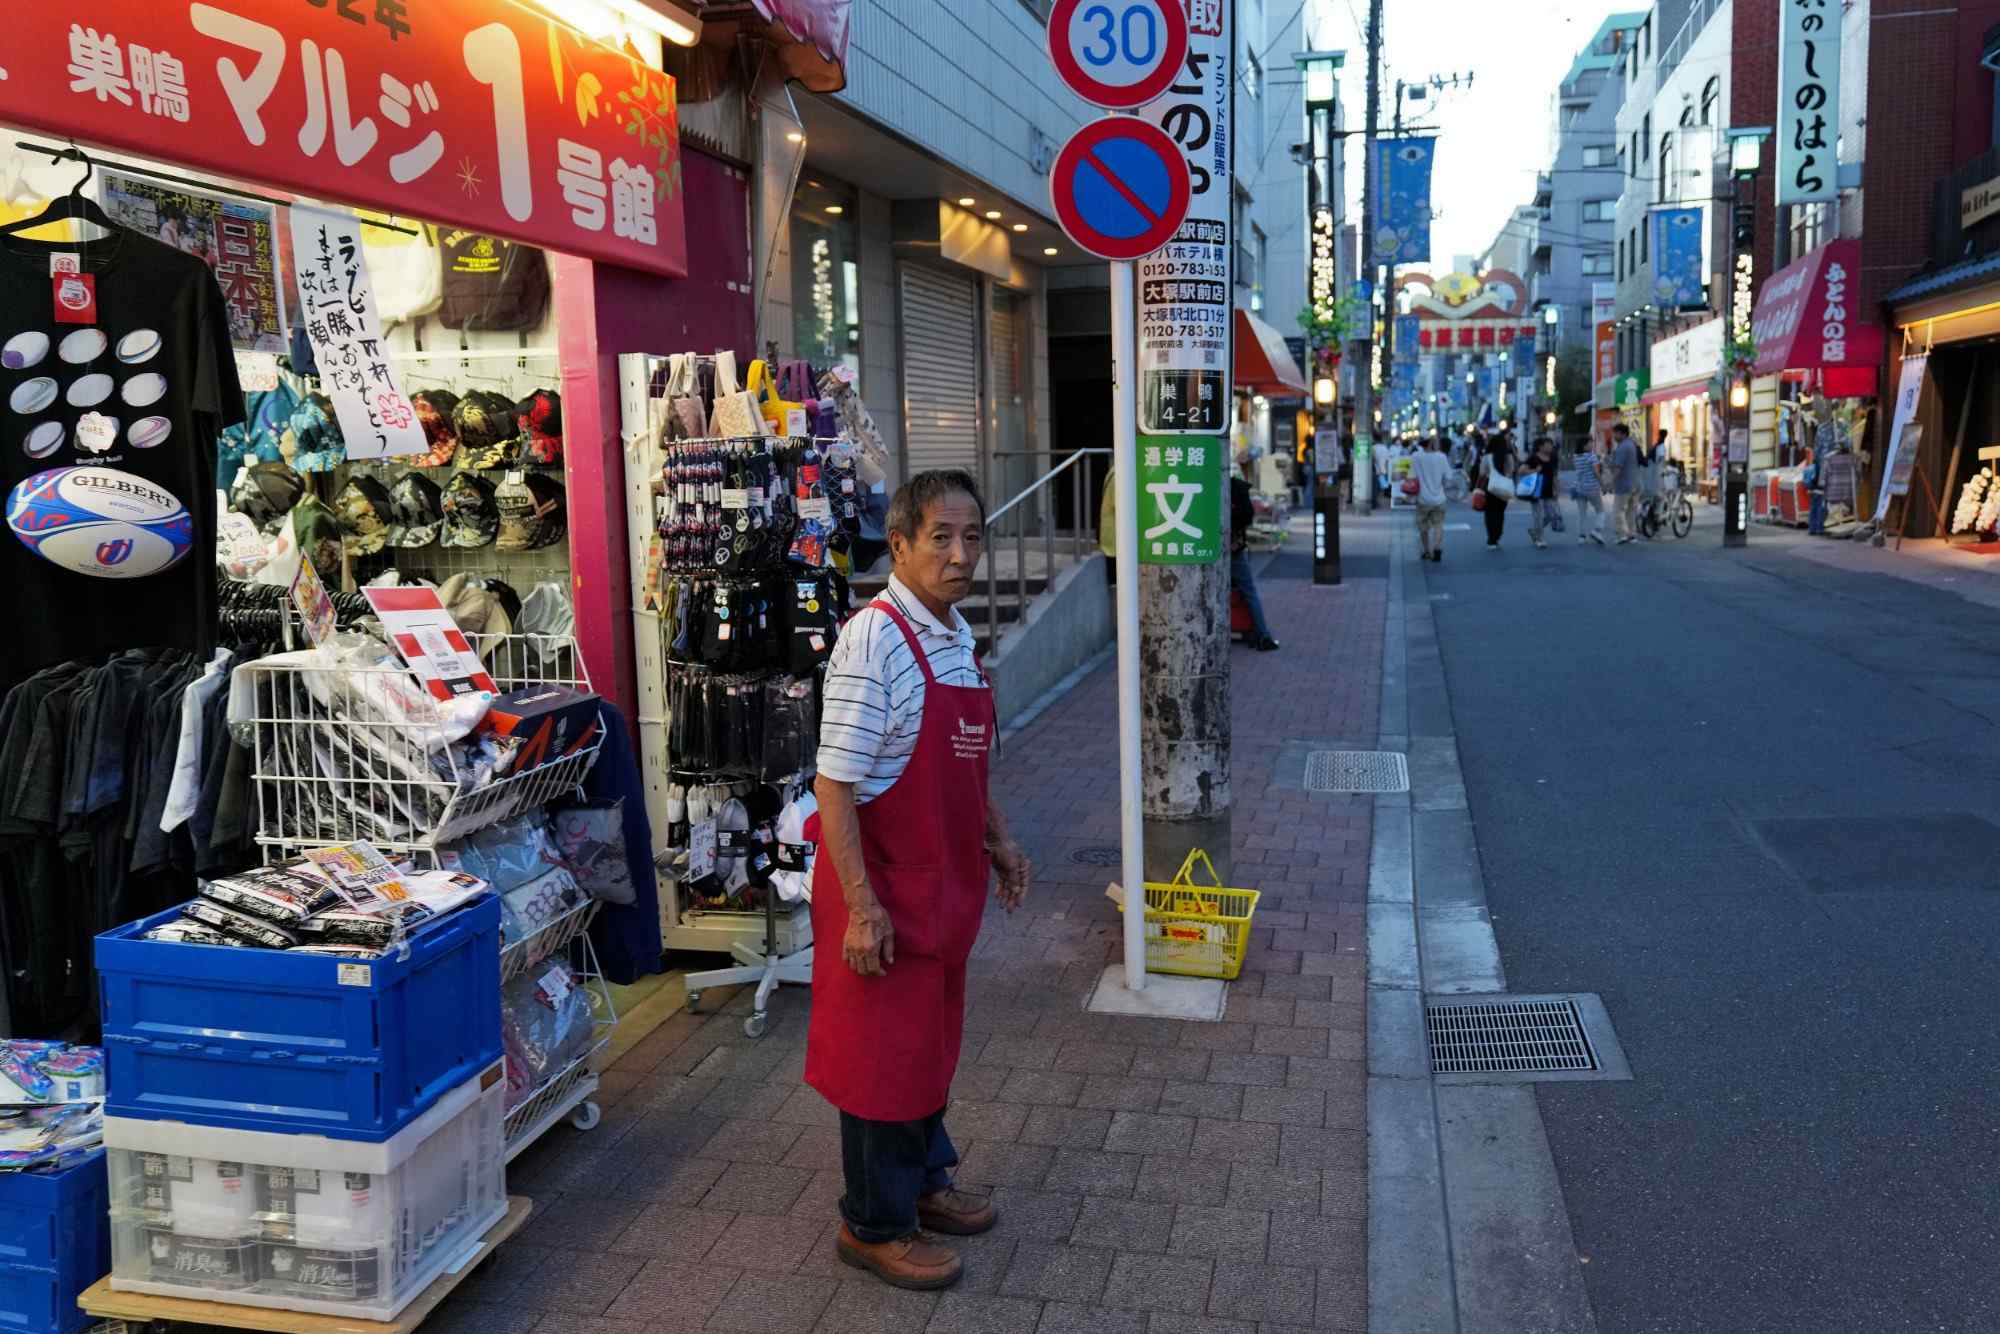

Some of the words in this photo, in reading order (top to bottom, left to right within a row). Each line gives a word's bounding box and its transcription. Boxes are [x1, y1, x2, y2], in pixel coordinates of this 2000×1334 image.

[1796, 0, 1826, 32] の
[1083, 5, 1156, 66] 30
[1795, 39, 1827, 193] しのはら
[1143, 262, 1225, 277] 0120-783-153
[1145, 282, 1225, 302] 大塚駅前店
[1143, 306, 1225, 323] 大塚駅北口1分
[1822, 262, 1847, 362] ふとんの店
[1143, 324, 1225, 338] 0120-783-517
[1161, 405, 1211, 423] 4-21
[1144, 446, 1206, 467] 通学路
[72, 474, 176, 511] GILBERT
[1145, 473, 1204, 540] 文
